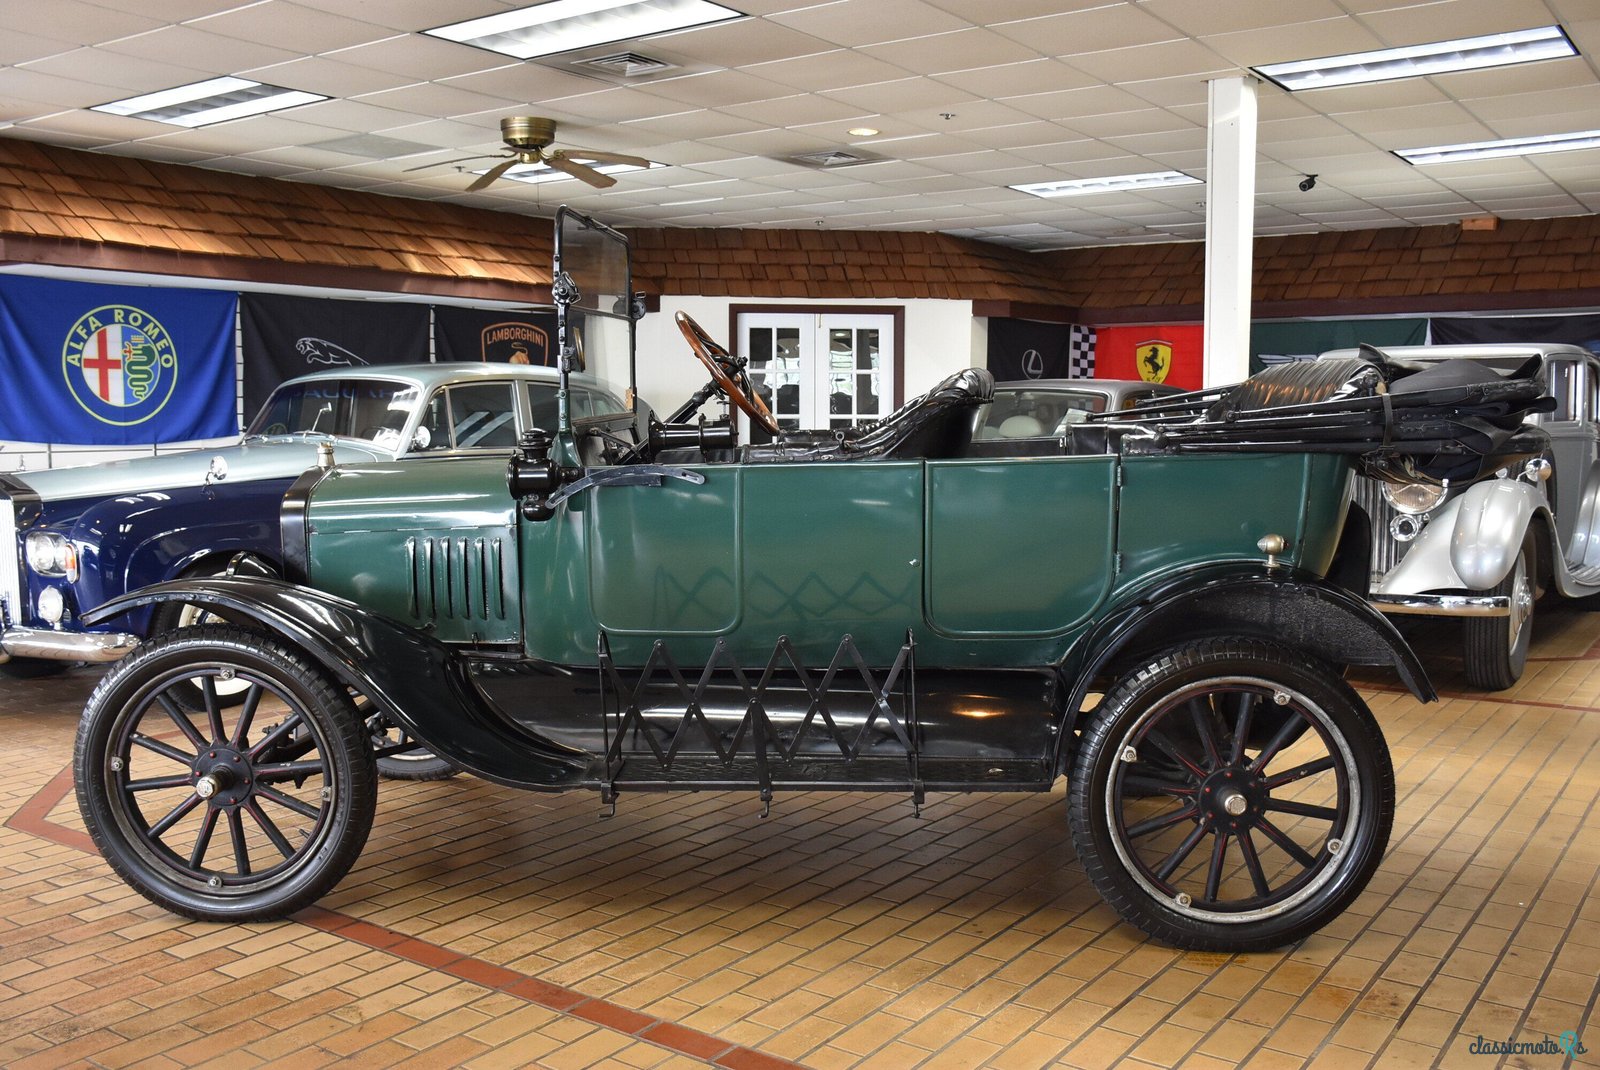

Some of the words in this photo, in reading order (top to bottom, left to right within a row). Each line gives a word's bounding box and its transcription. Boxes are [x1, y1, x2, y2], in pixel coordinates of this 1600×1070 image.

[66, 316, 103, 367] ALFA
[114, 309, 174, 369] ROMEO
[486, 327, 544, 348] LAMBORGHINI
